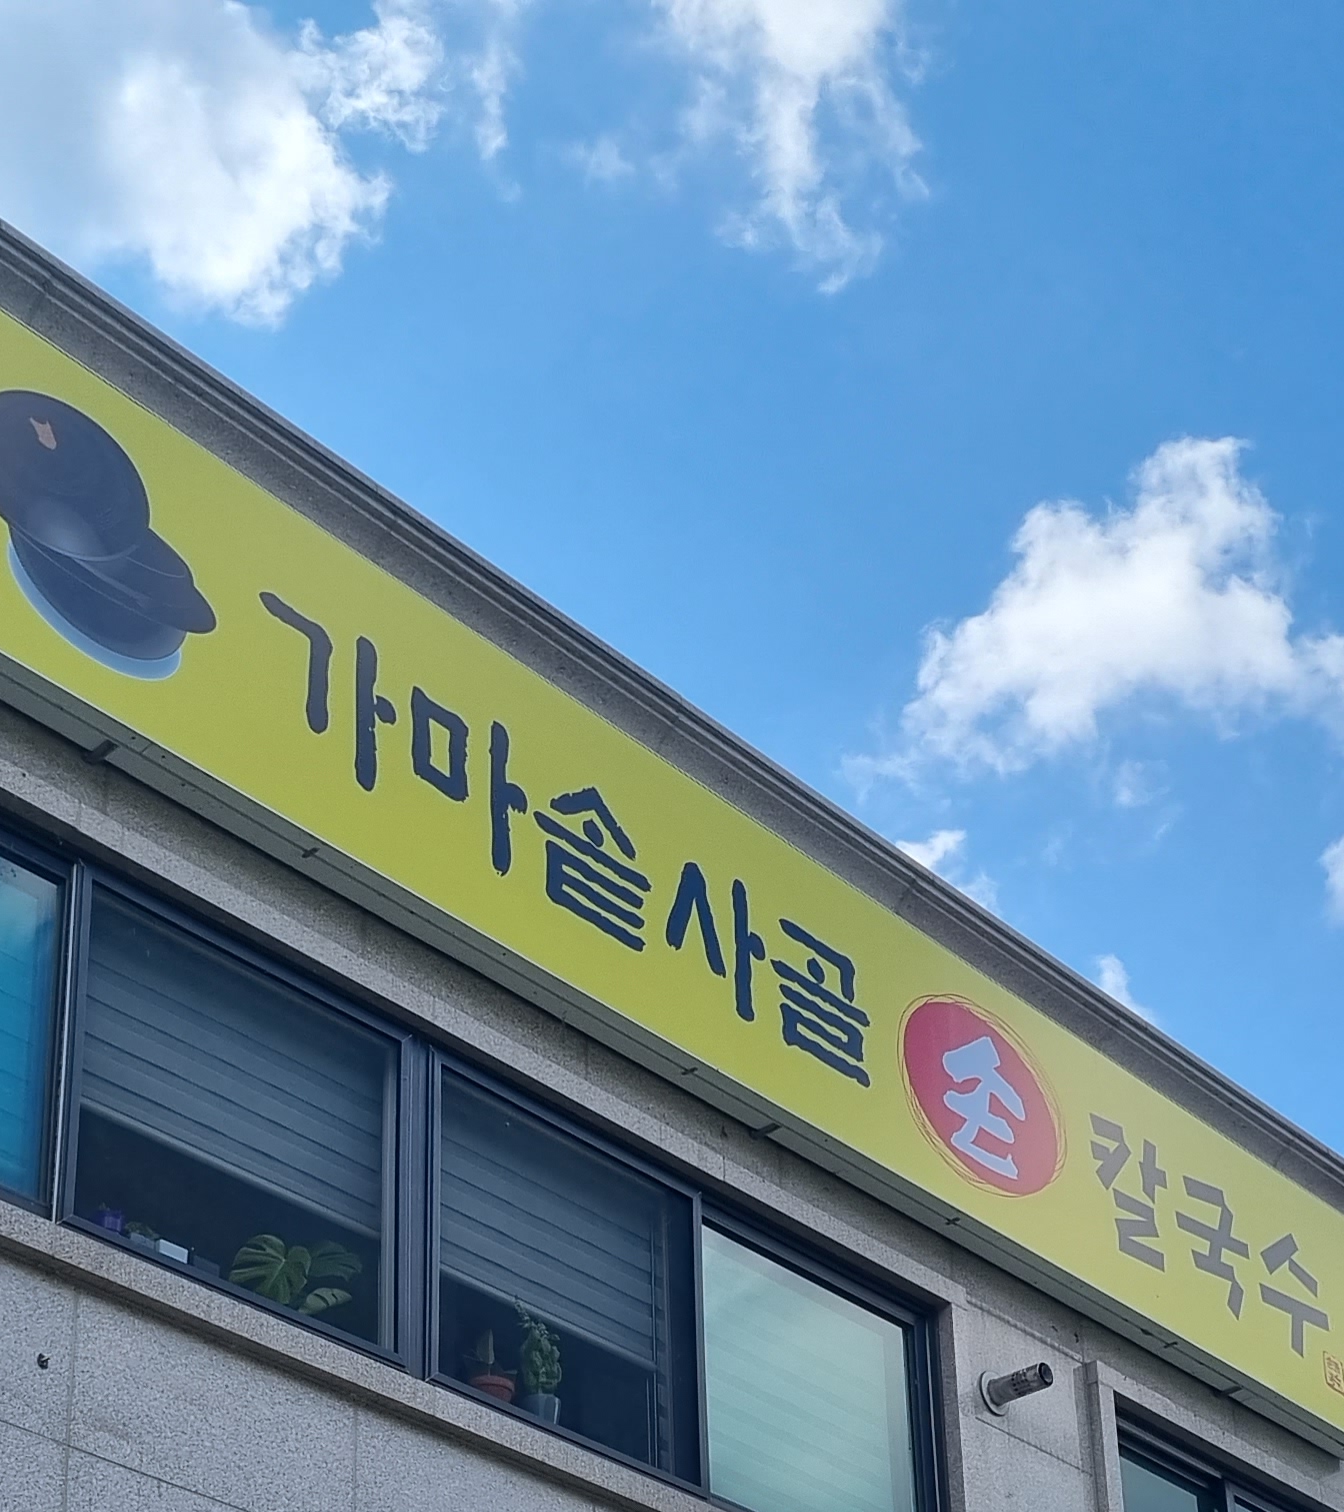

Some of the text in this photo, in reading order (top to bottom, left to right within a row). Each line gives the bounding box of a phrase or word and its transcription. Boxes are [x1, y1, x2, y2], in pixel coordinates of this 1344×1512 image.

[259, 590, 1329, 1358] 가마솥사골 손 칼국수
